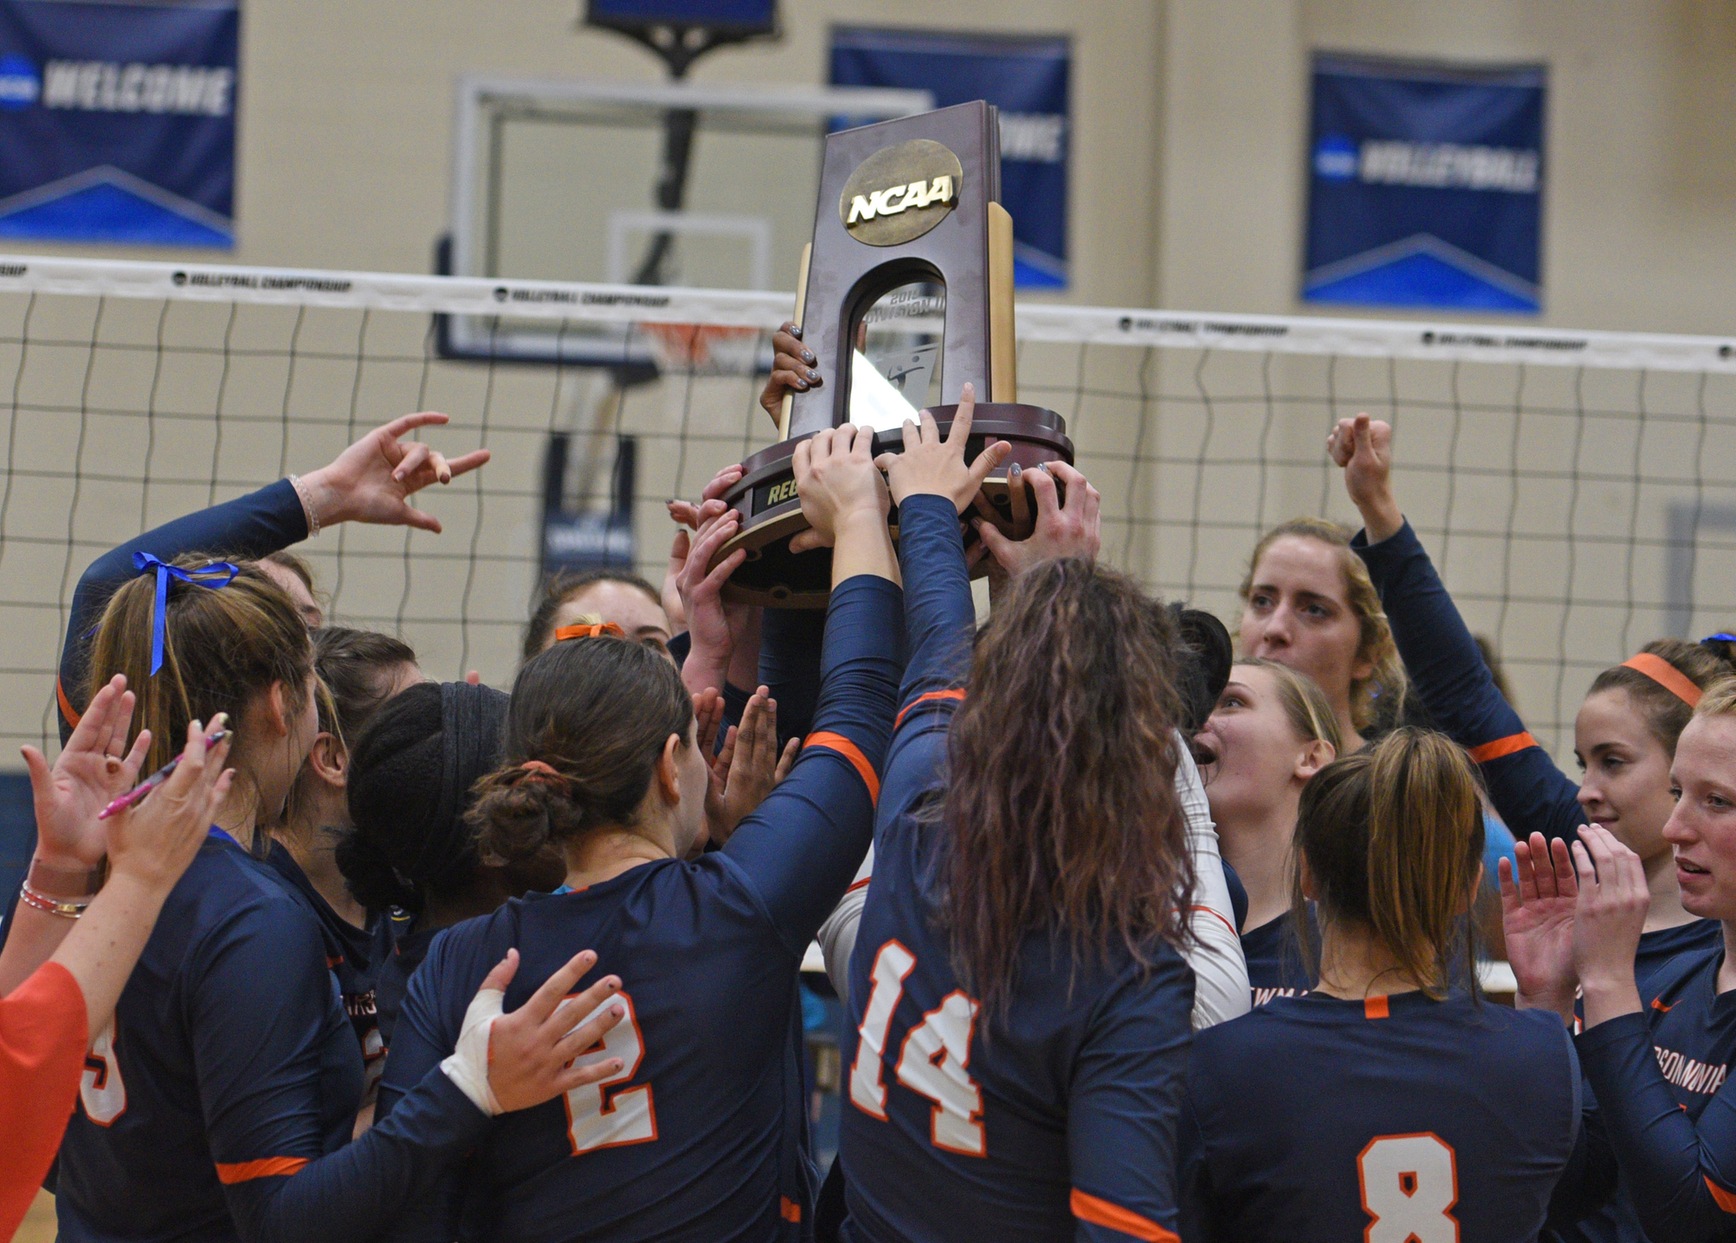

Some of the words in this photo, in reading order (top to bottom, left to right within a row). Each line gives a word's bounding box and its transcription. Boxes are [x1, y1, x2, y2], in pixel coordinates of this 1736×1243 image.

[44, 60, 233, 117] WELCOME
[846, 175, 953, 228] NCAA
[557, 989, 658, 1157] 2
[849, 938, 987, 1158] 14
[1356, 1130, 1461, 1243] 8
